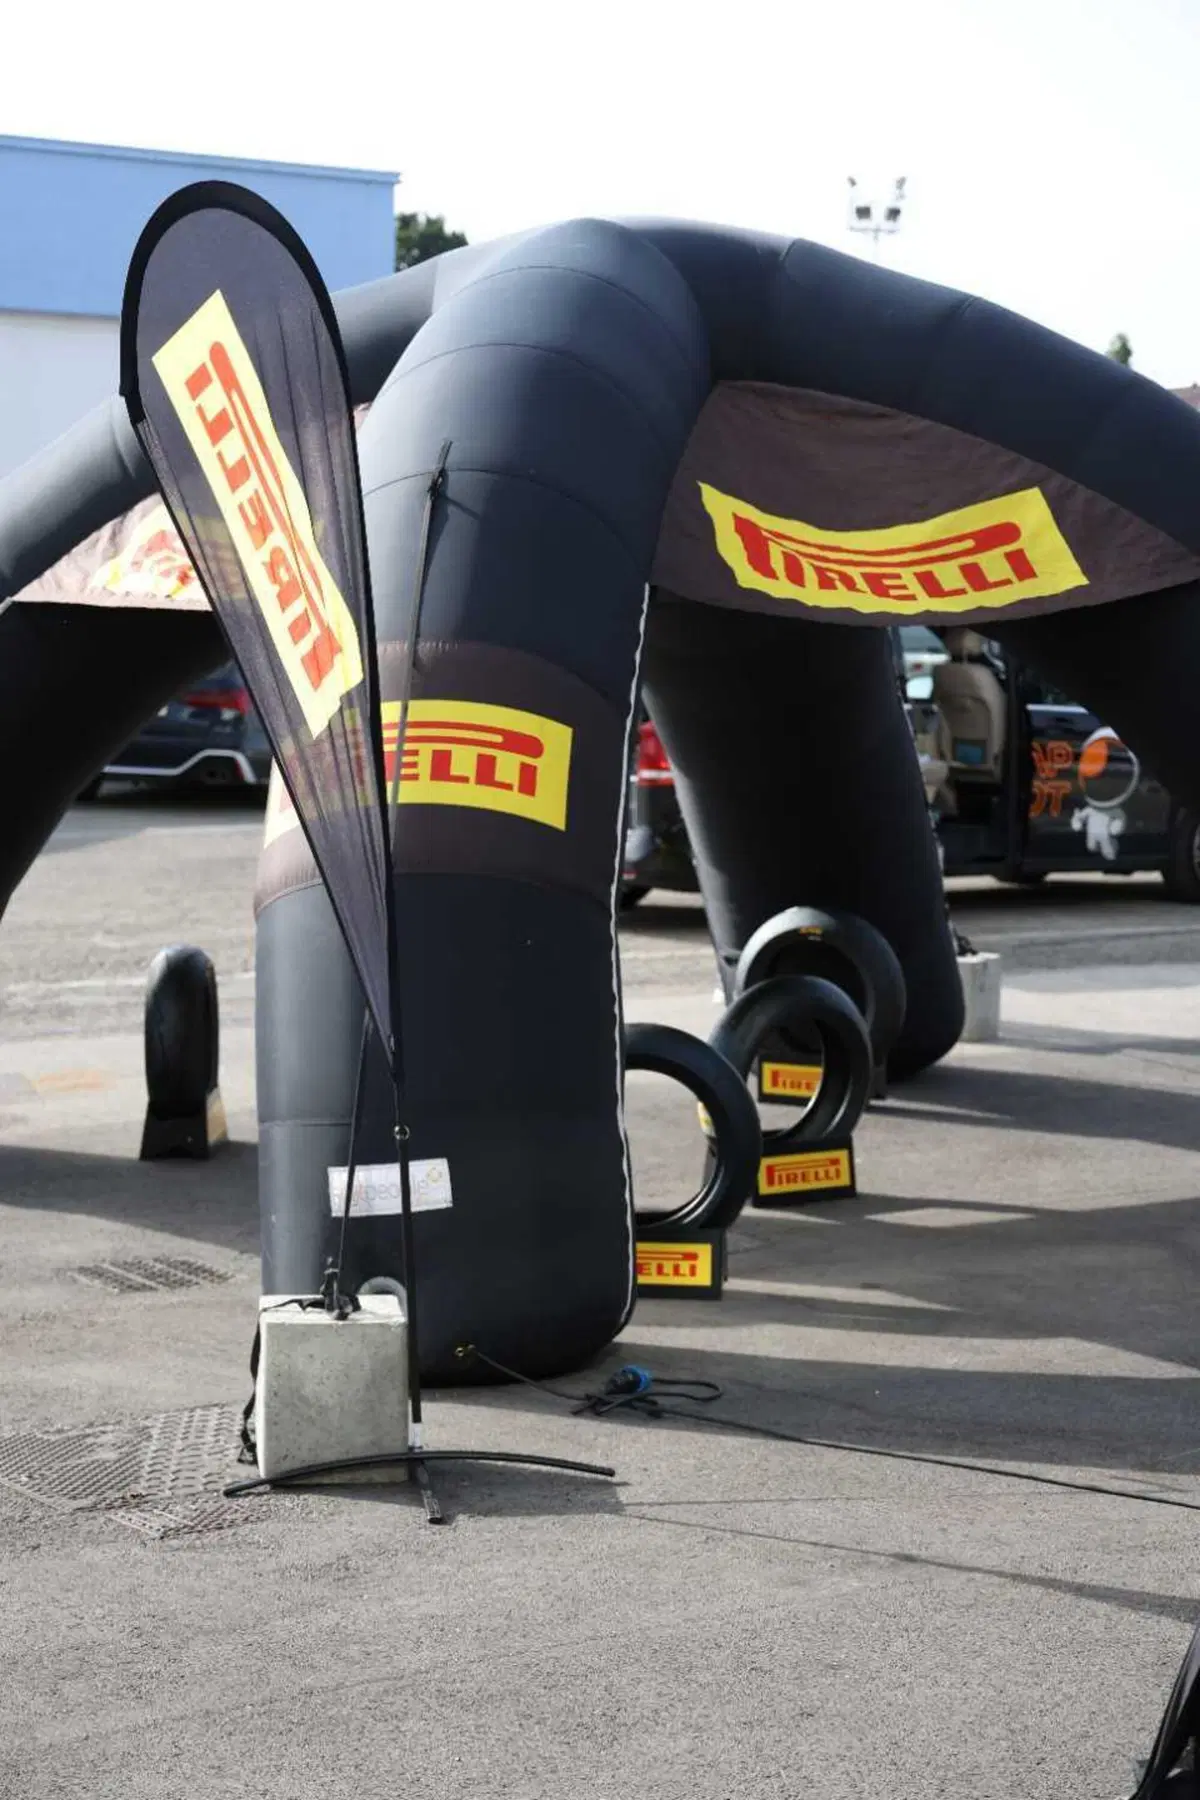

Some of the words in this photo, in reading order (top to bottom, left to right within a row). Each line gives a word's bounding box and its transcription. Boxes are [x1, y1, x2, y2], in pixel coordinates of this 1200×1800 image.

[732, 512, 1037, 601] PIRELLI
[383, 721, 545, 798] ELLI
[765, 1157, 841, 1188] PIRELLI
[637, 1250, 699, 1278] ELLI
